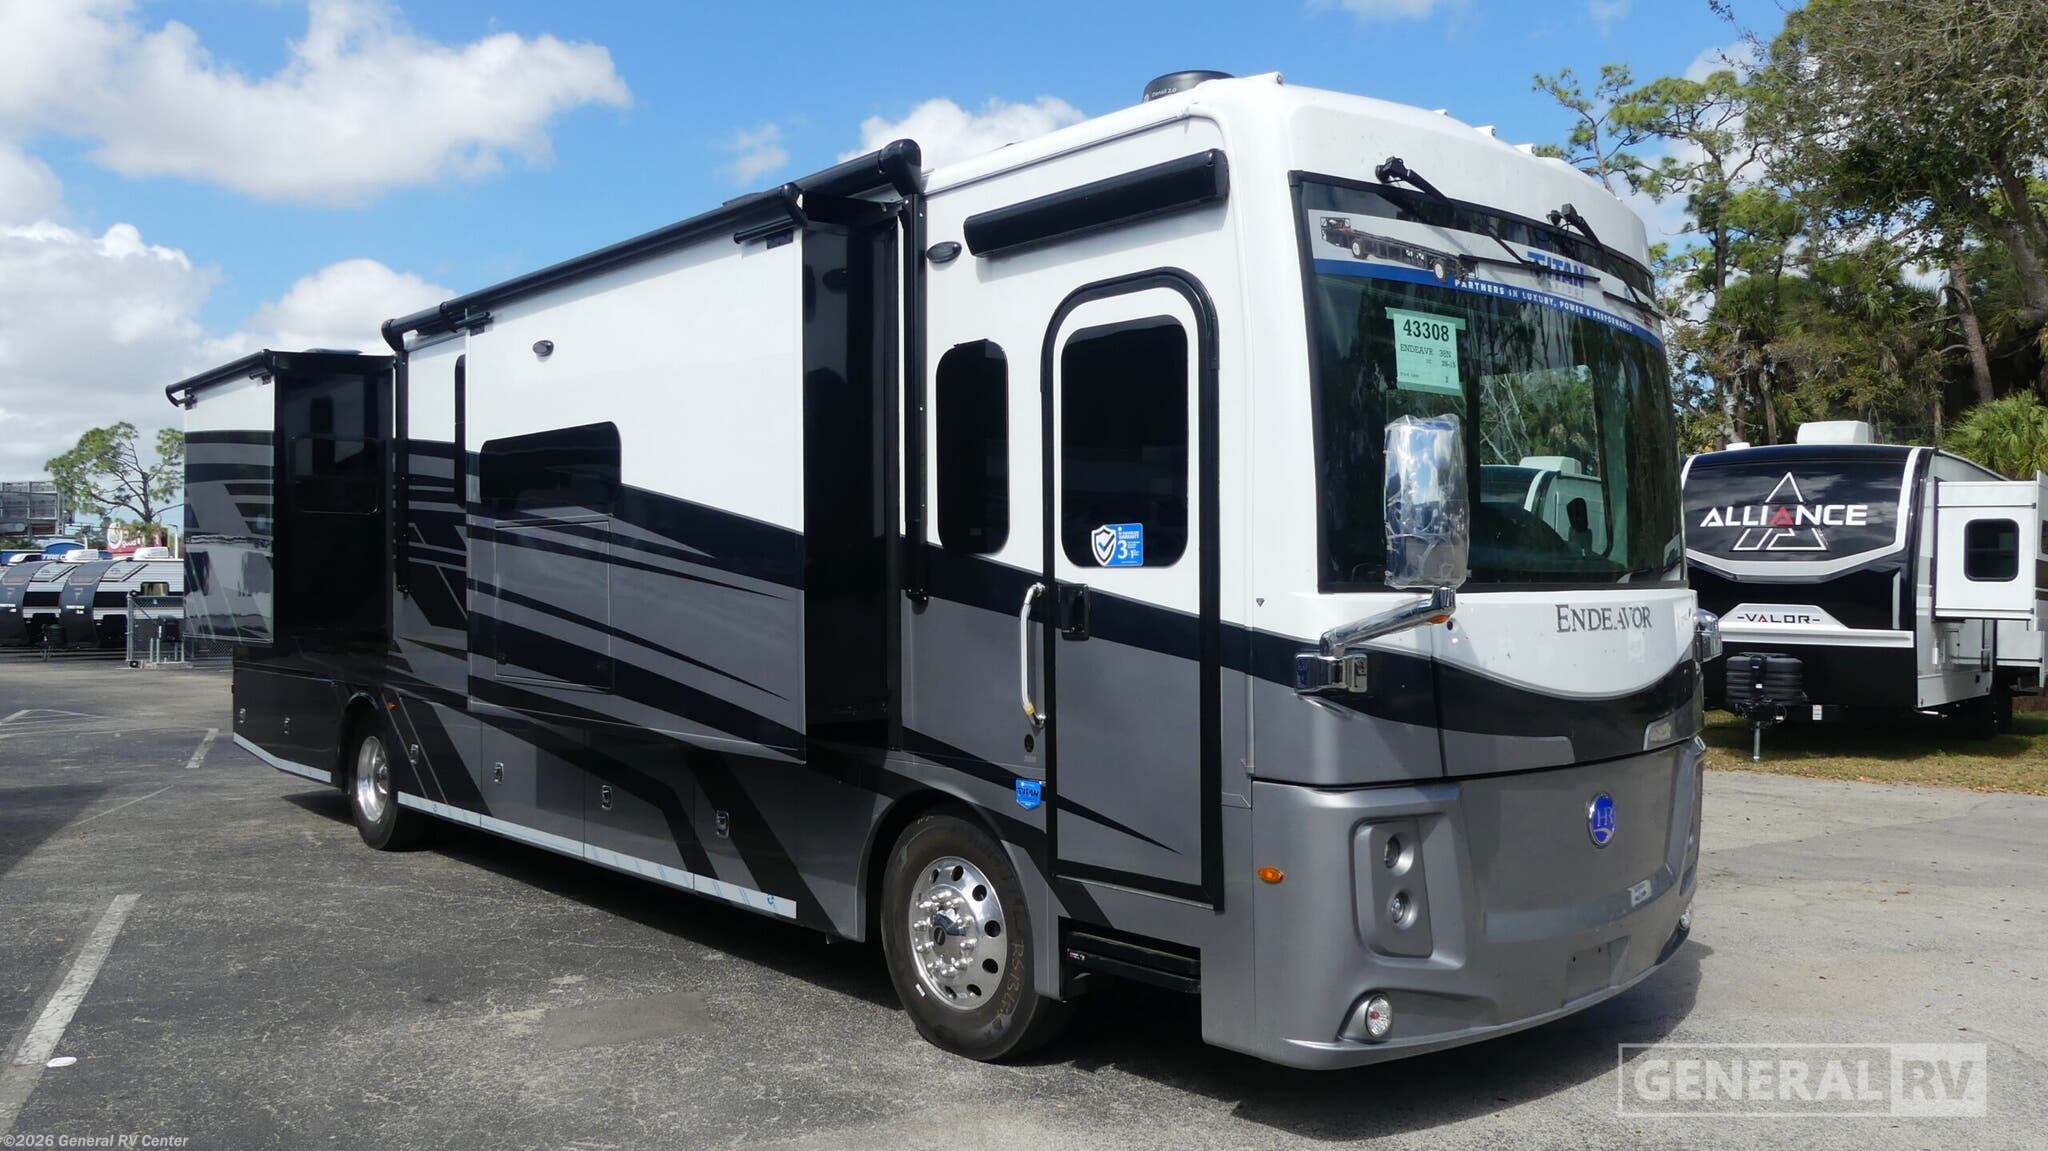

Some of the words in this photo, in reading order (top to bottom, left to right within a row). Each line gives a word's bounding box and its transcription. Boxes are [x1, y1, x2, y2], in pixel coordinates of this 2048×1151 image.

[1527, 251, 1585, 289] TITAN
[1454, 279, 1505, 295] PARTNERS
[1508, 288, 1519, 298] IN
[1522, 291, 1557, 308] LUXURY,
[1559, 300, 1584, 314] POWER
[1592, 311, 1633, 332] PERFORMANCE
[1403, 319, 1450, 342] 43308
[1699, 504, 1869, 527] ALLIANCE
[1117, 539, 1128, 559] 3
[1555, 604, 1652, 633] ENDEAVOR
